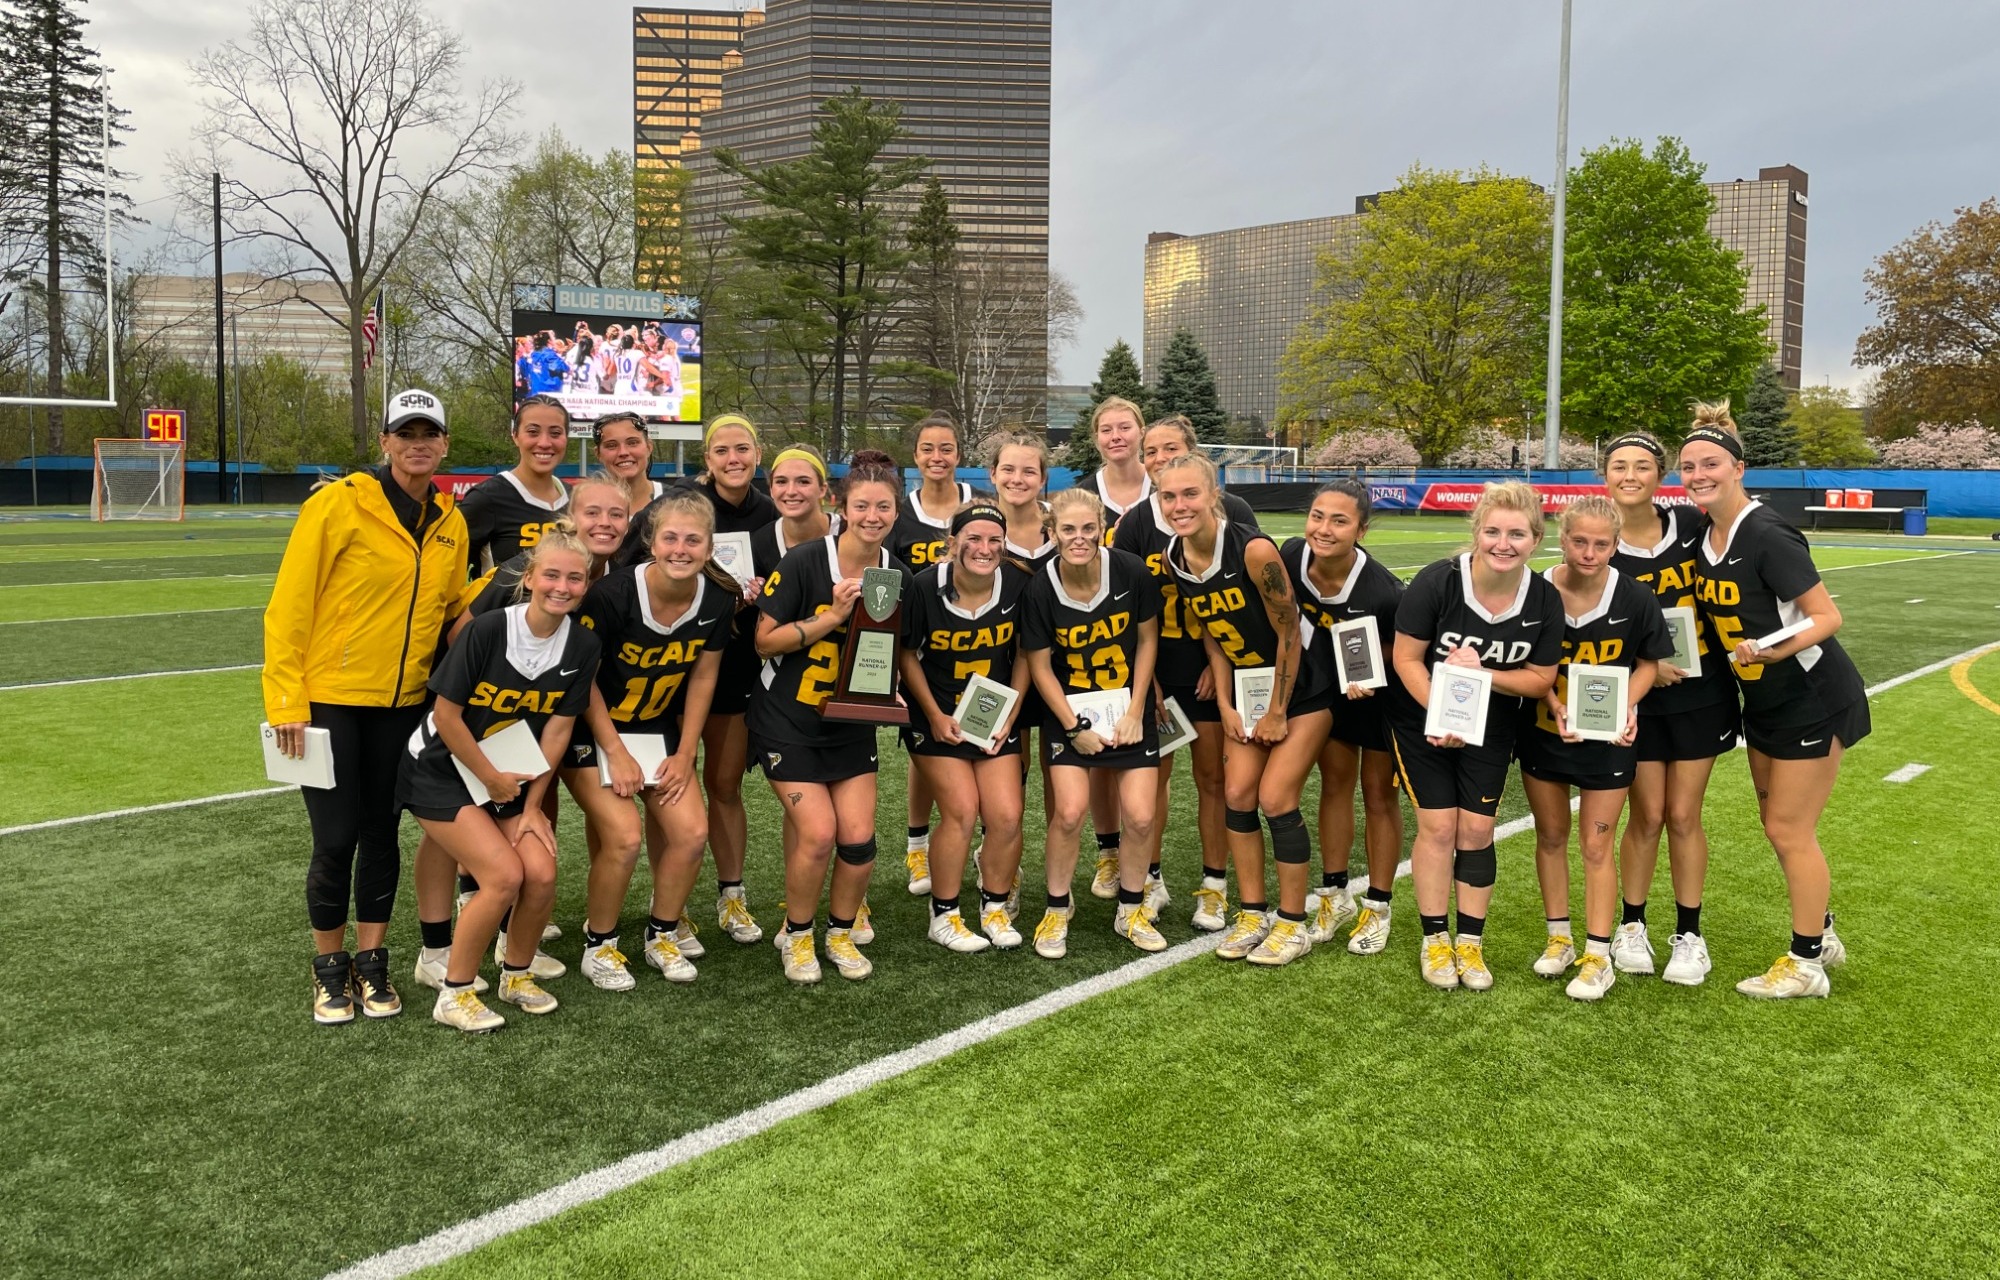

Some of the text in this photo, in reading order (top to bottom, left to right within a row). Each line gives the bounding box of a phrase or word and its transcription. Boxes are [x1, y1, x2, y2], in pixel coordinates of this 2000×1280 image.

[559, 290, 661, 313] BLUE DEVILS
[400, 393, 434, 409] SCAD
[584, 398, 616, 406] NATIONAL
[618, 399, 657, 407] CHAMPIONS
[147, 413, 181, 442] 90
[1371, 487, 1407, 504] NAIA
[436, 534, 456, 547] SCAD
[763, 571, 782, 597] C
[1184, 587, 1246, 618] CAD
[930, 621, 1014, 651] SCAD
[1055, 611, 1130, 649] SCAD
[617, 639, 707, 669] SCAD
[1066, 643, 1130, 691] 13
[468, 681, 566, 714] SCAD
[607, 672, 687, 723] 10
